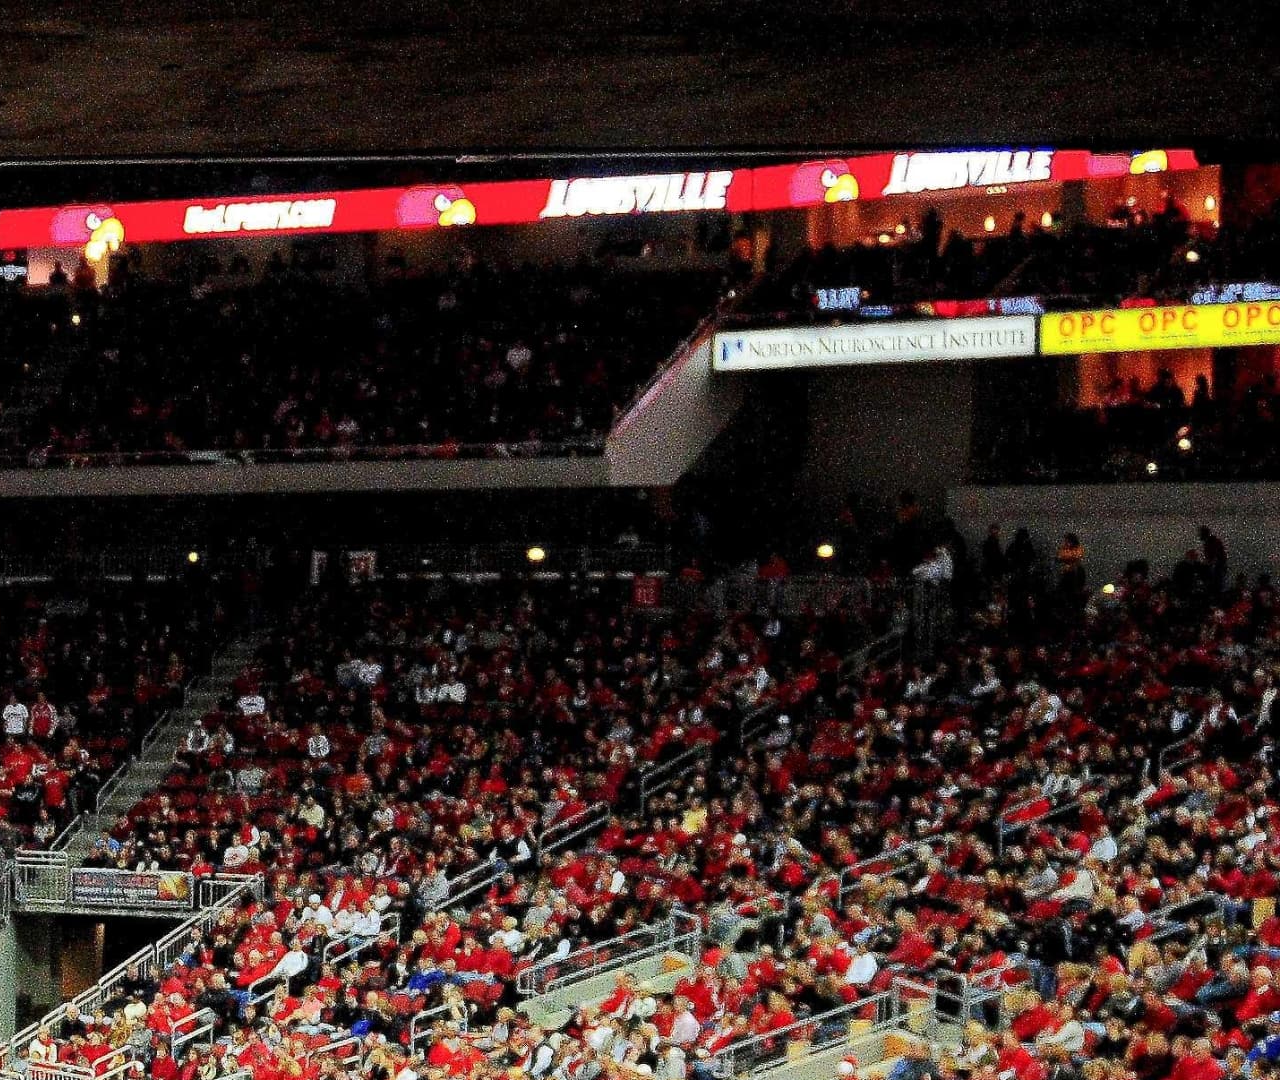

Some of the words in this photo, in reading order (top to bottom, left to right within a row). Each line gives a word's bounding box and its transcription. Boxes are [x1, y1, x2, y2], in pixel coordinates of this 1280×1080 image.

[1058, 313, 1116, 338] OPC
[1139, 306, 1199, 333] OPC
[747, 338, 814, 360] NORTON
[817, 333, 936, 357] NEUROSCIENCE
[940, 330, 1027, 352] INSTITUTE
